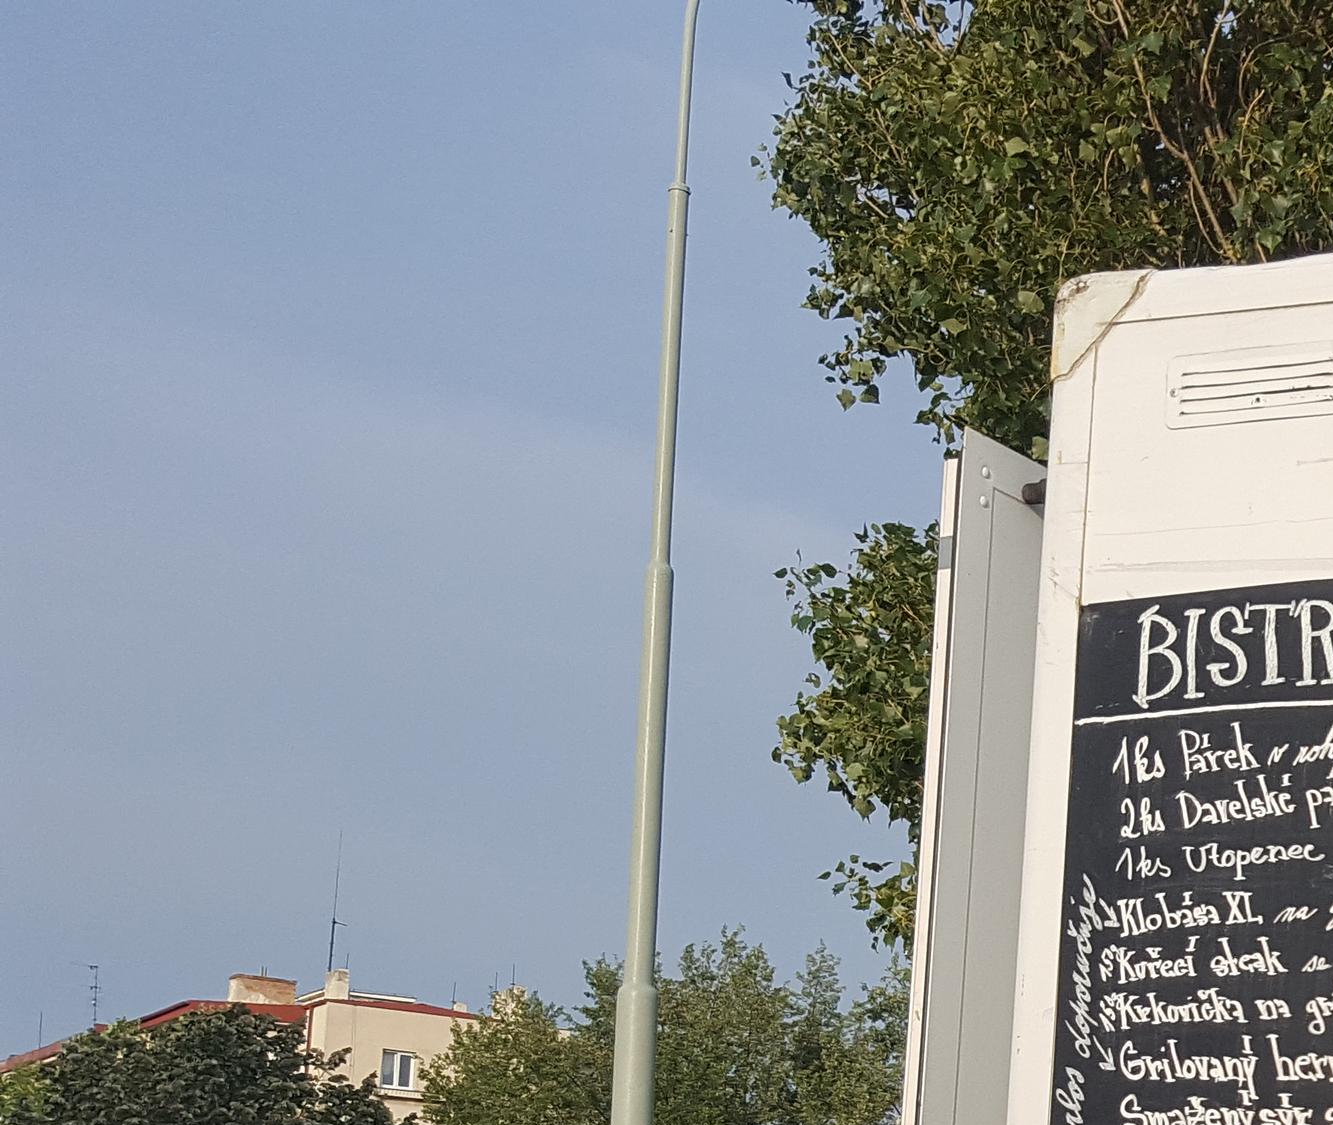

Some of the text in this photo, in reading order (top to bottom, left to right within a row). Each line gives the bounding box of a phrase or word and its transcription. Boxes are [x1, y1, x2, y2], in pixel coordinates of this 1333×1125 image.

[1112, 735, 1166, 785] 1ks
[1179, 721, 1260, 780] Párek
[1119, 797, 1166, 838] 2ks
[1115, 846, 1172, 881] 1ks
[1182, 842, 1325, 881] Utopenec
[1116, 890, 1222, 938] Klobása
[1222, 890, 1264, 926] XL
[1274, 905, 1318, 925] na
[1116, 935, 1200, 985] Kuřecí
[1210, 935, 1290, 977] steak
[1301, 953, 1333, 973] se
[1116, 986, 1249, 1031] Krkovička
[1258, 997, 1292, 1021] na
[1119, 1035, 1259, 1103] Grilovaný
